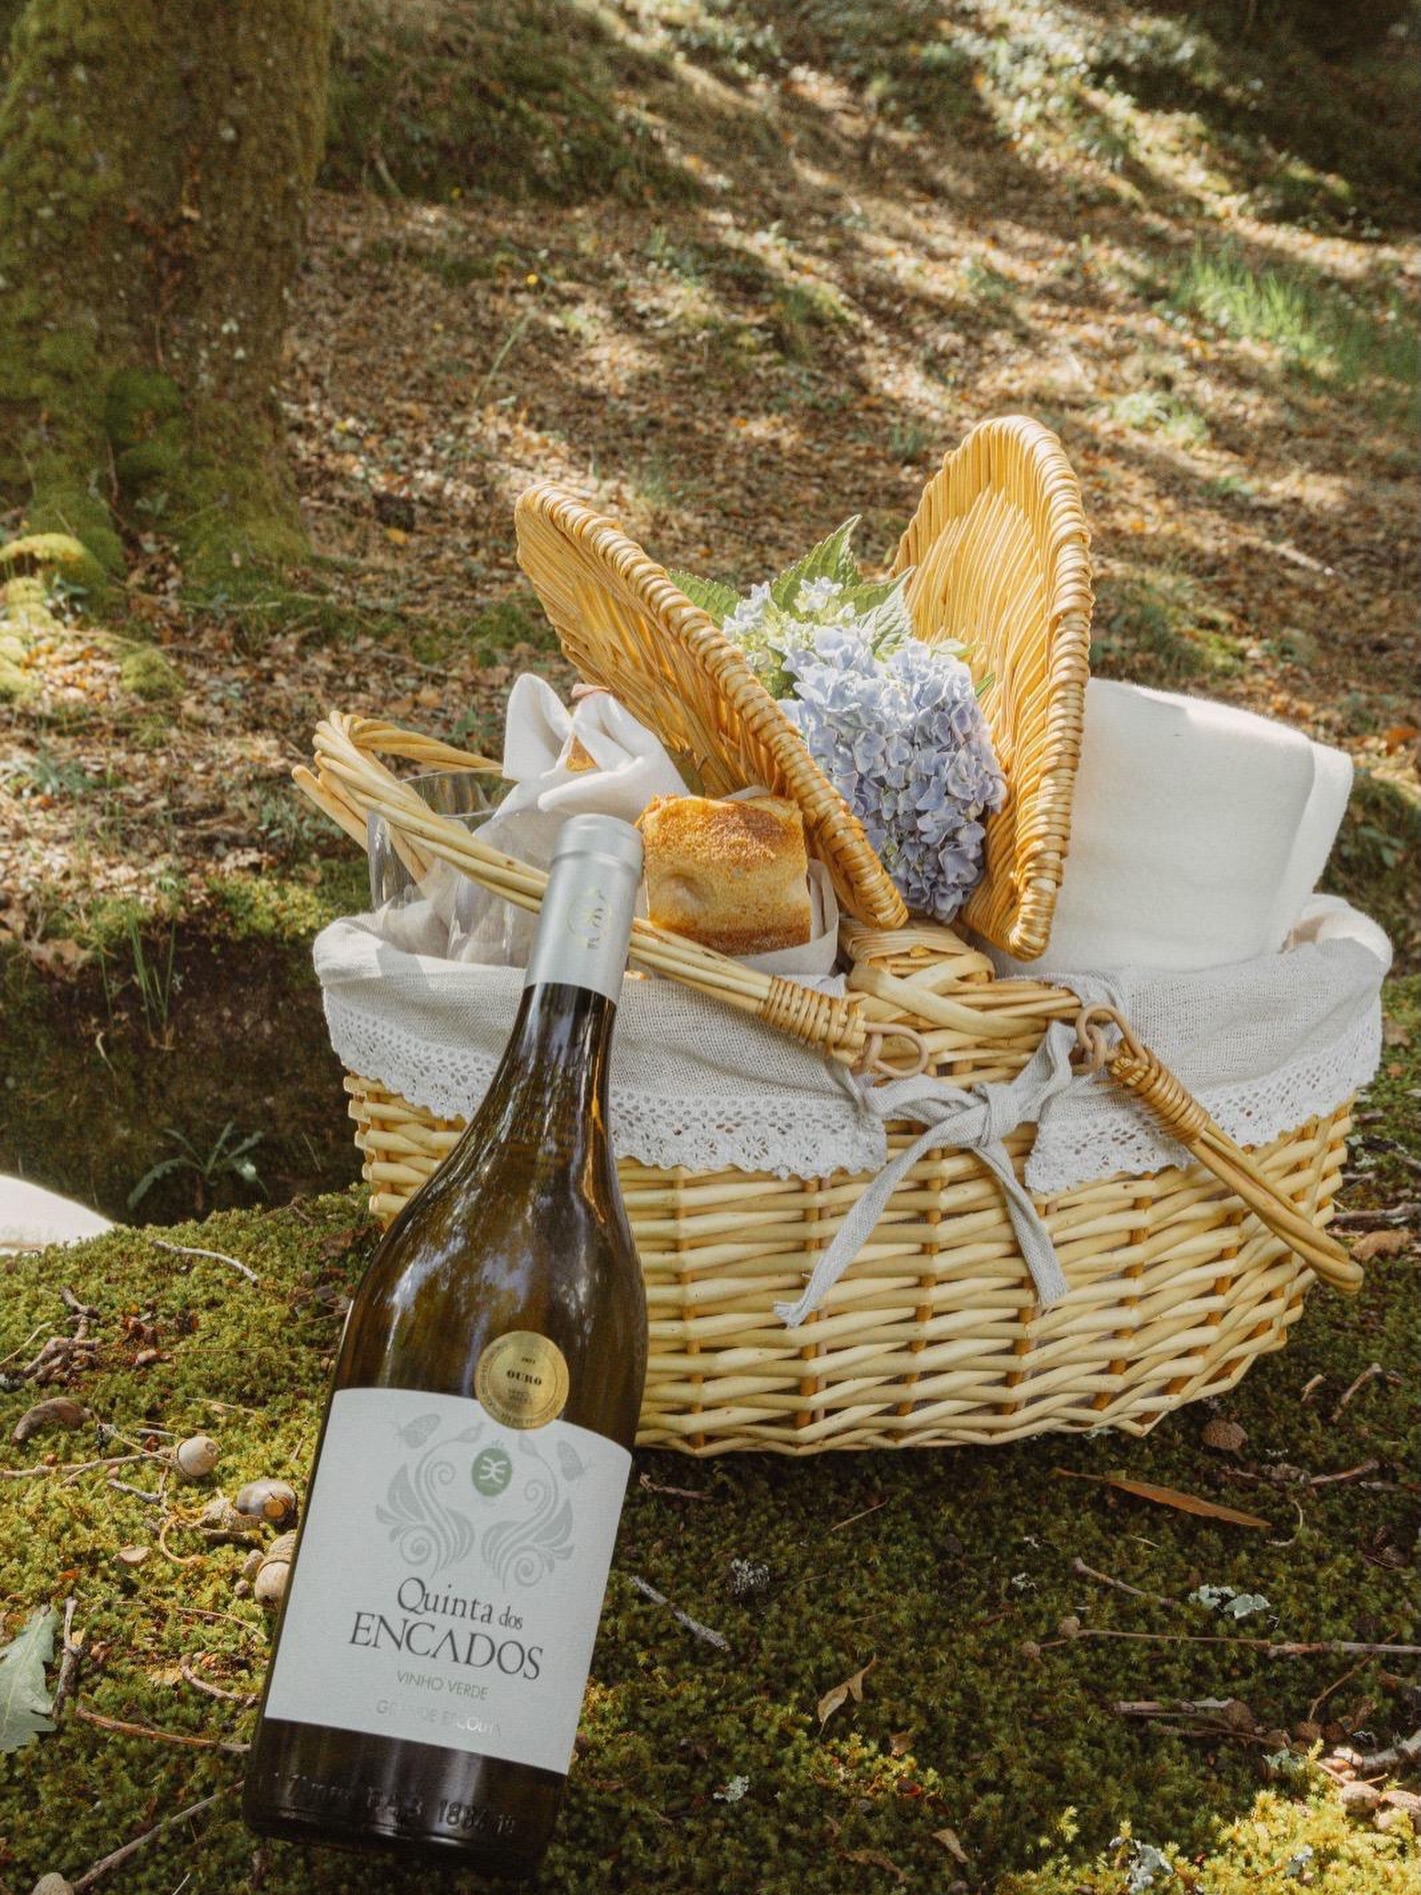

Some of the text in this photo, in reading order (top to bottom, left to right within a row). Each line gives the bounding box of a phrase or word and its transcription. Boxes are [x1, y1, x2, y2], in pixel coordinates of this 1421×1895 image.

[506, 1370, 542, 1386] OURO
[397, 1577, 524, 1630] Quinta dos
[348, 1611, 544, 1680] ENCADOS
[397, 1671, 490, 1701] VINHO VERDE
